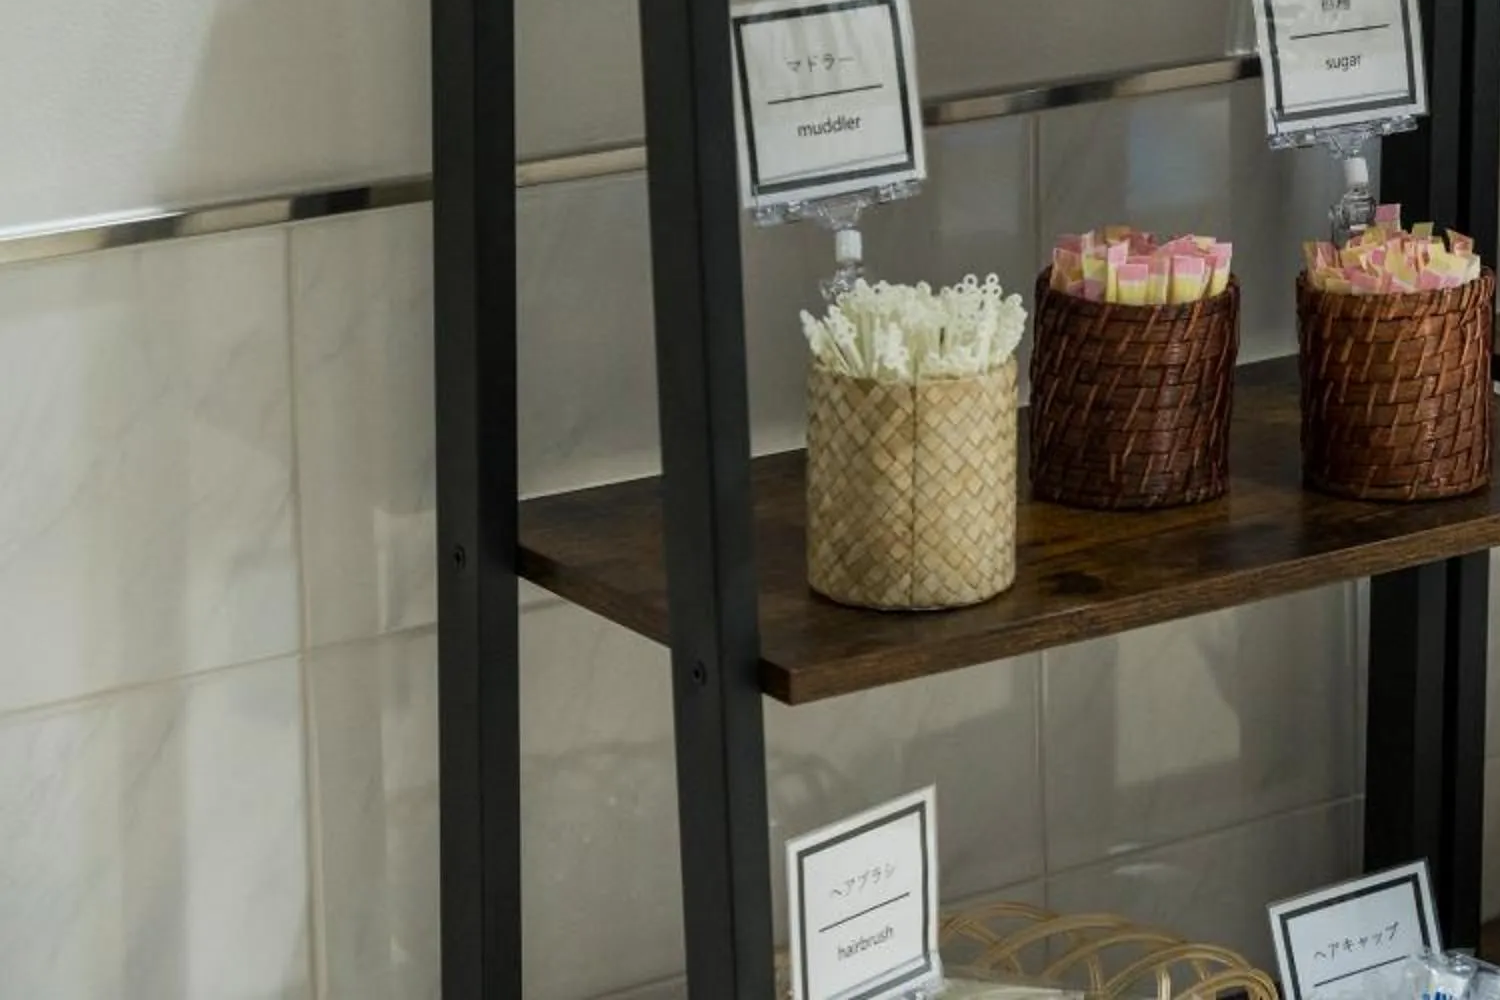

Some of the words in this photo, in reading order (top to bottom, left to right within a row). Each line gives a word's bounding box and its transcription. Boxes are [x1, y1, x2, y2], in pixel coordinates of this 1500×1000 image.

[786, 52, 855, 73] マドラー
[1324, 54, 1361, 72] sugar
[797, 115, 861, 137] muddler
[837, 926, 895, 961] hairbrush
[1312, 920, 1400, 960] ヘアキャップ
